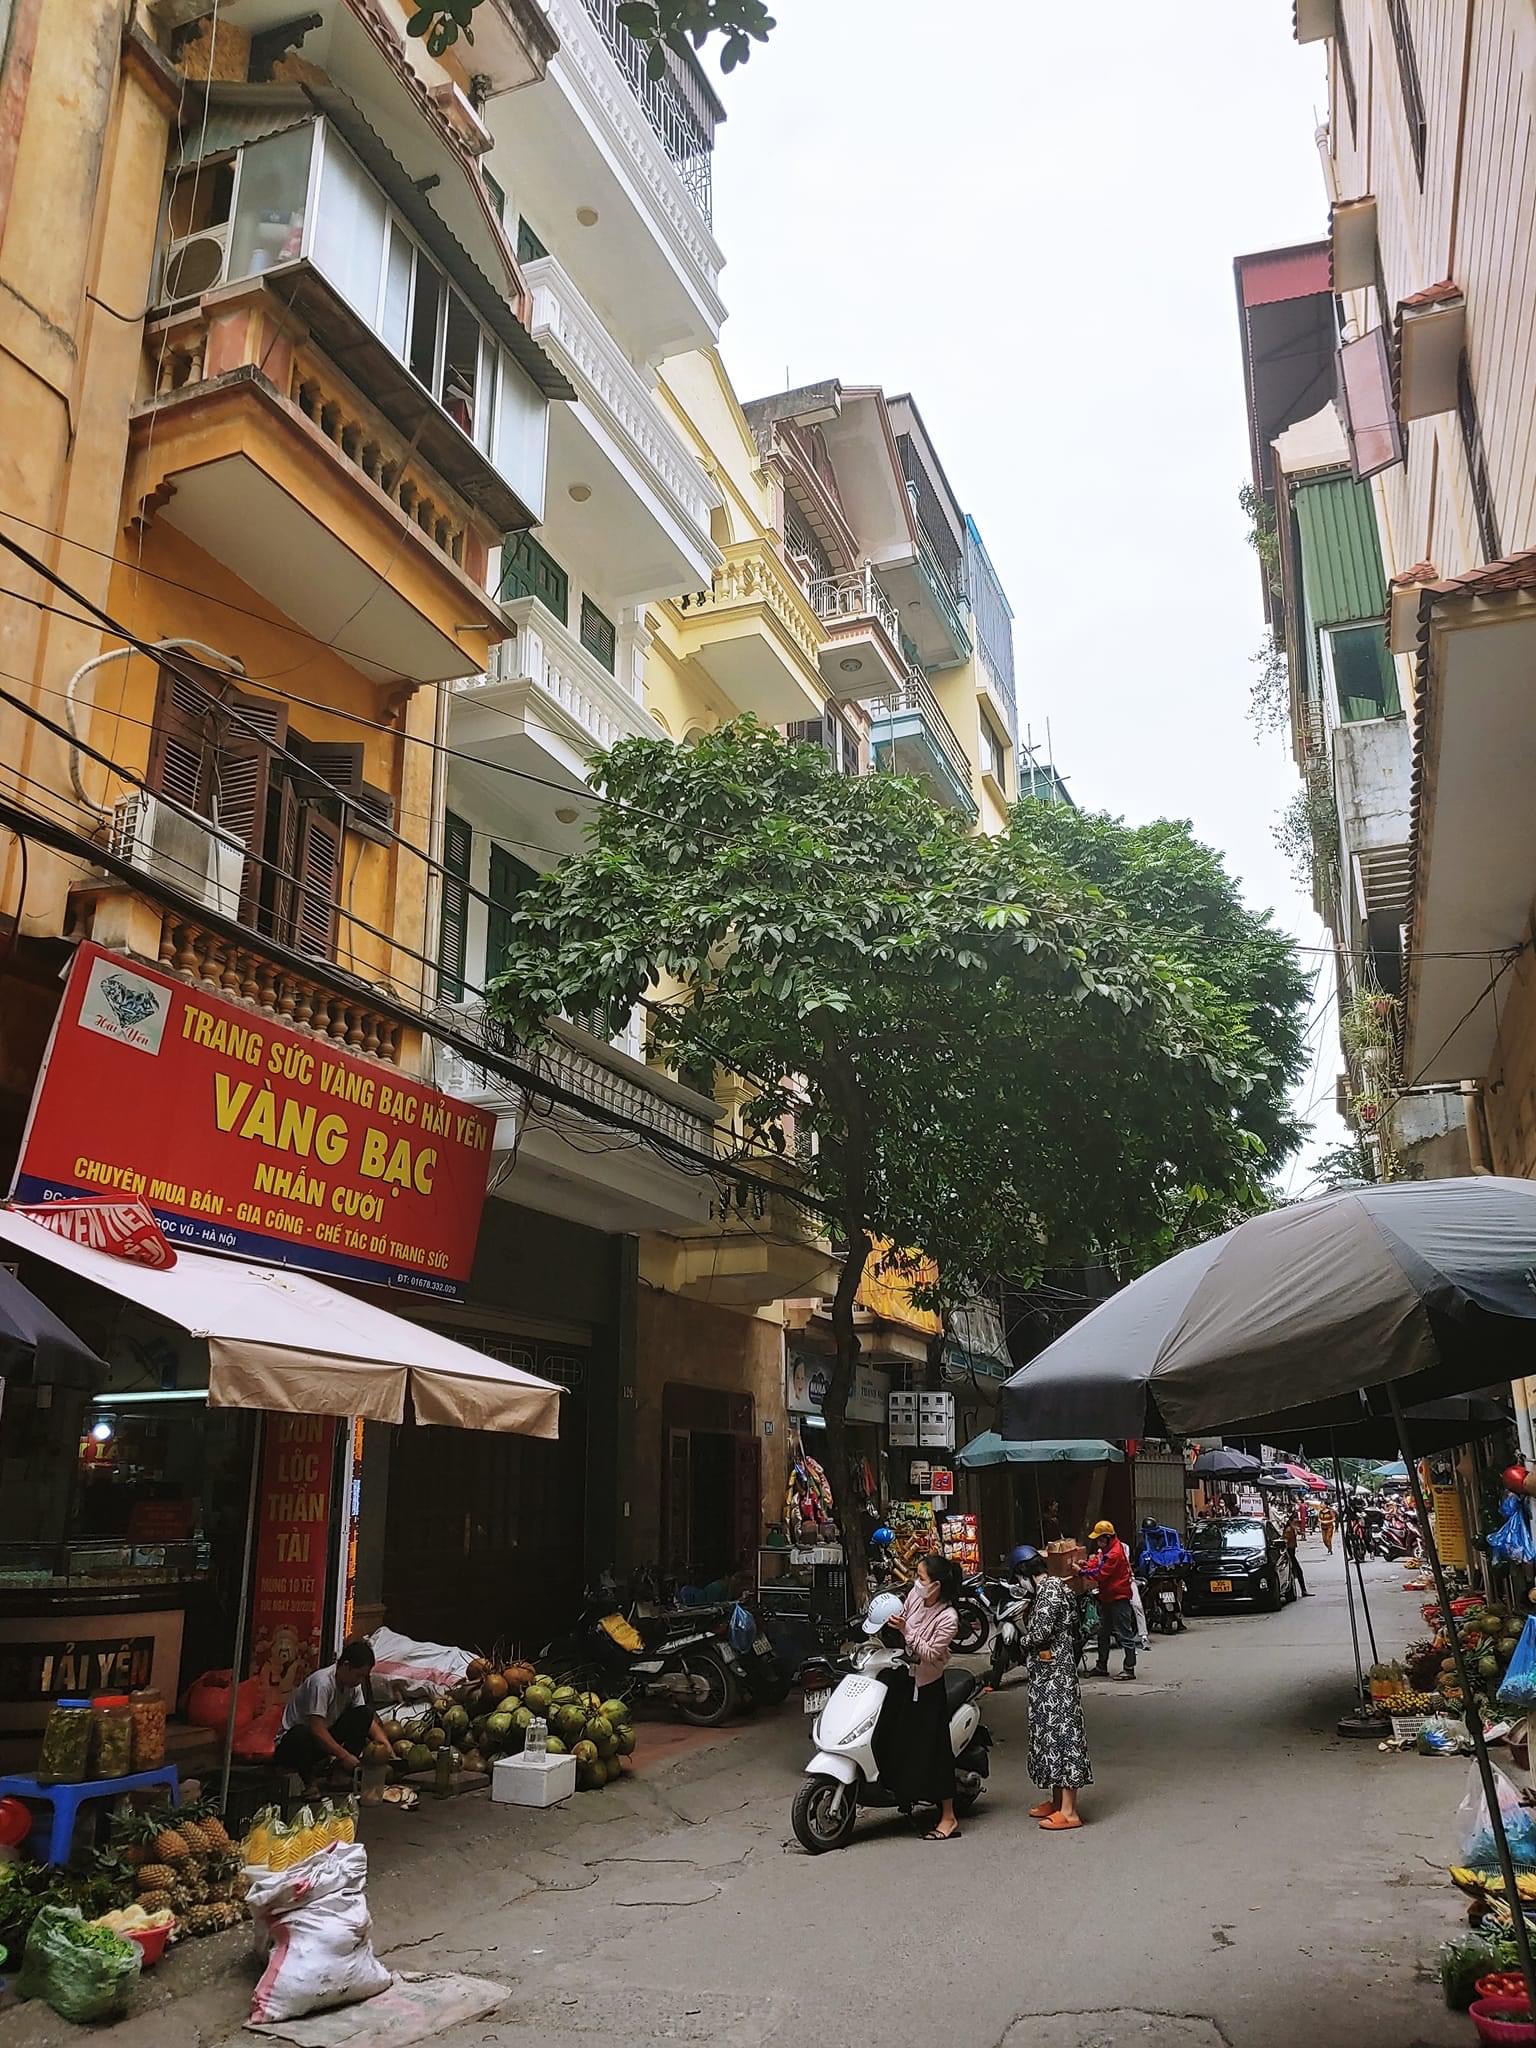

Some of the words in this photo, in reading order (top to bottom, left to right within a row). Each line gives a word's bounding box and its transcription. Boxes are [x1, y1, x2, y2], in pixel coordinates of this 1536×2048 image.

[182, 1003, 263, 1067] TRANG
[267, 1041, 315, 1085] SỨC
[320, 1060, 375, 1110] VÀNG
[378, 1085, 417, 1125] BẠC
[420, 1099, 452, 1138] HẢI
[456, 1114, 487, 1152] YẾN
[215, 1072, 349, 1166] VÀNG
[360, 1127, 438, 1198] BẠC
[74, 1156, 147, 1195] CHUYÊN
[149, 1178, 187, 1206] MUA
[190, 1190, 225, 1216] BÁN
[236, 1202, 261, 1225] GIA
[265, 1209, 304, 1235] CÔNG
[315, 1223, 345, 1244] CHẾ
[345, 1229, 368, 1250] TÁC
[390, 1241, 425, 1265] TRANG
[427, 1249, 449, 1270] SỨC
[180, 1223, 195, 1236] VŨ
[202, 1228, 216, 1242] HÀ
[218, 1232, 237, 1247] NỘI
[254, 1162, 327, 1207] NHẪN
[331, 1186, 385, 1223] CƯỚI
